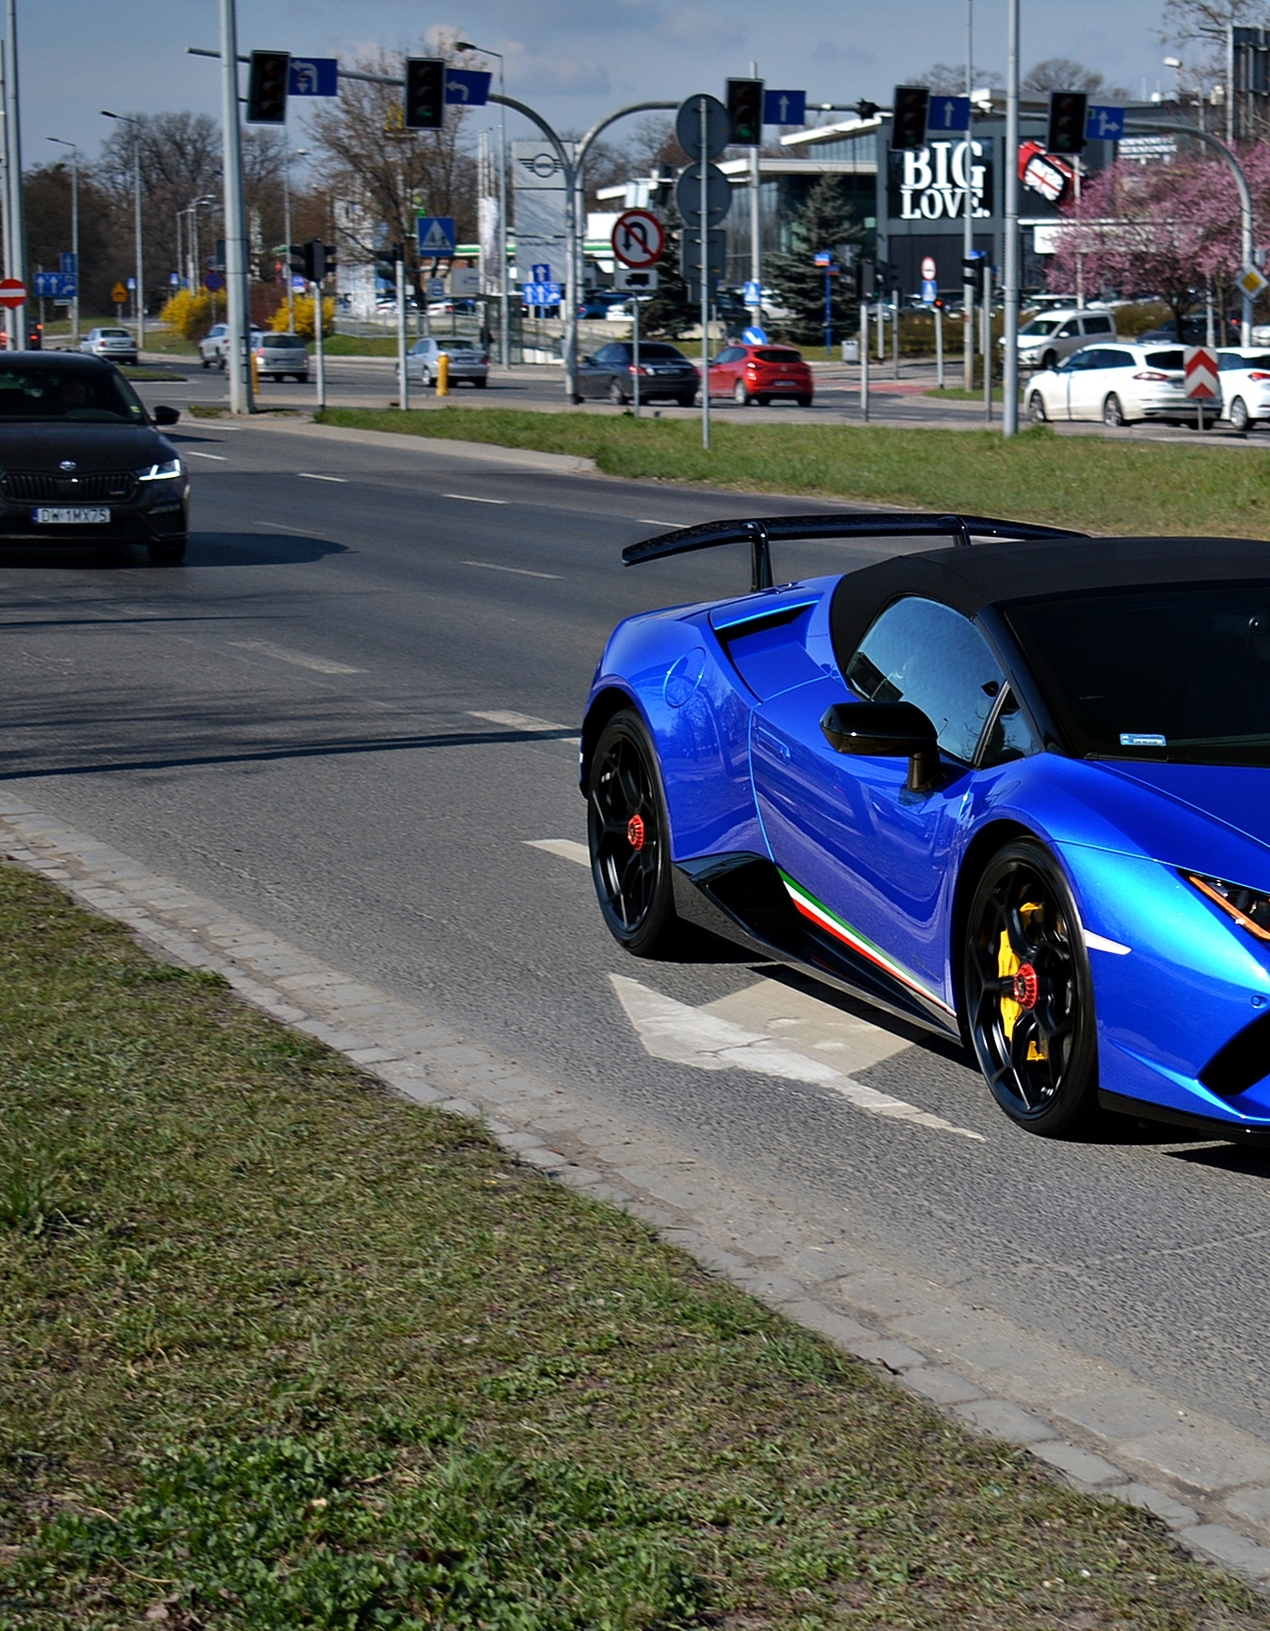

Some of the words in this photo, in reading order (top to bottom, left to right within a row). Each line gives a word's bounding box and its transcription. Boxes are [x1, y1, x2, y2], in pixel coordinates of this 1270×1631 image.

[901, 141, 986, 190] BIG
[900, 188, 990, 219] LOVE.
[42, 509, 59, 522] DW
[66, 509, 107, 522] 1MX75
